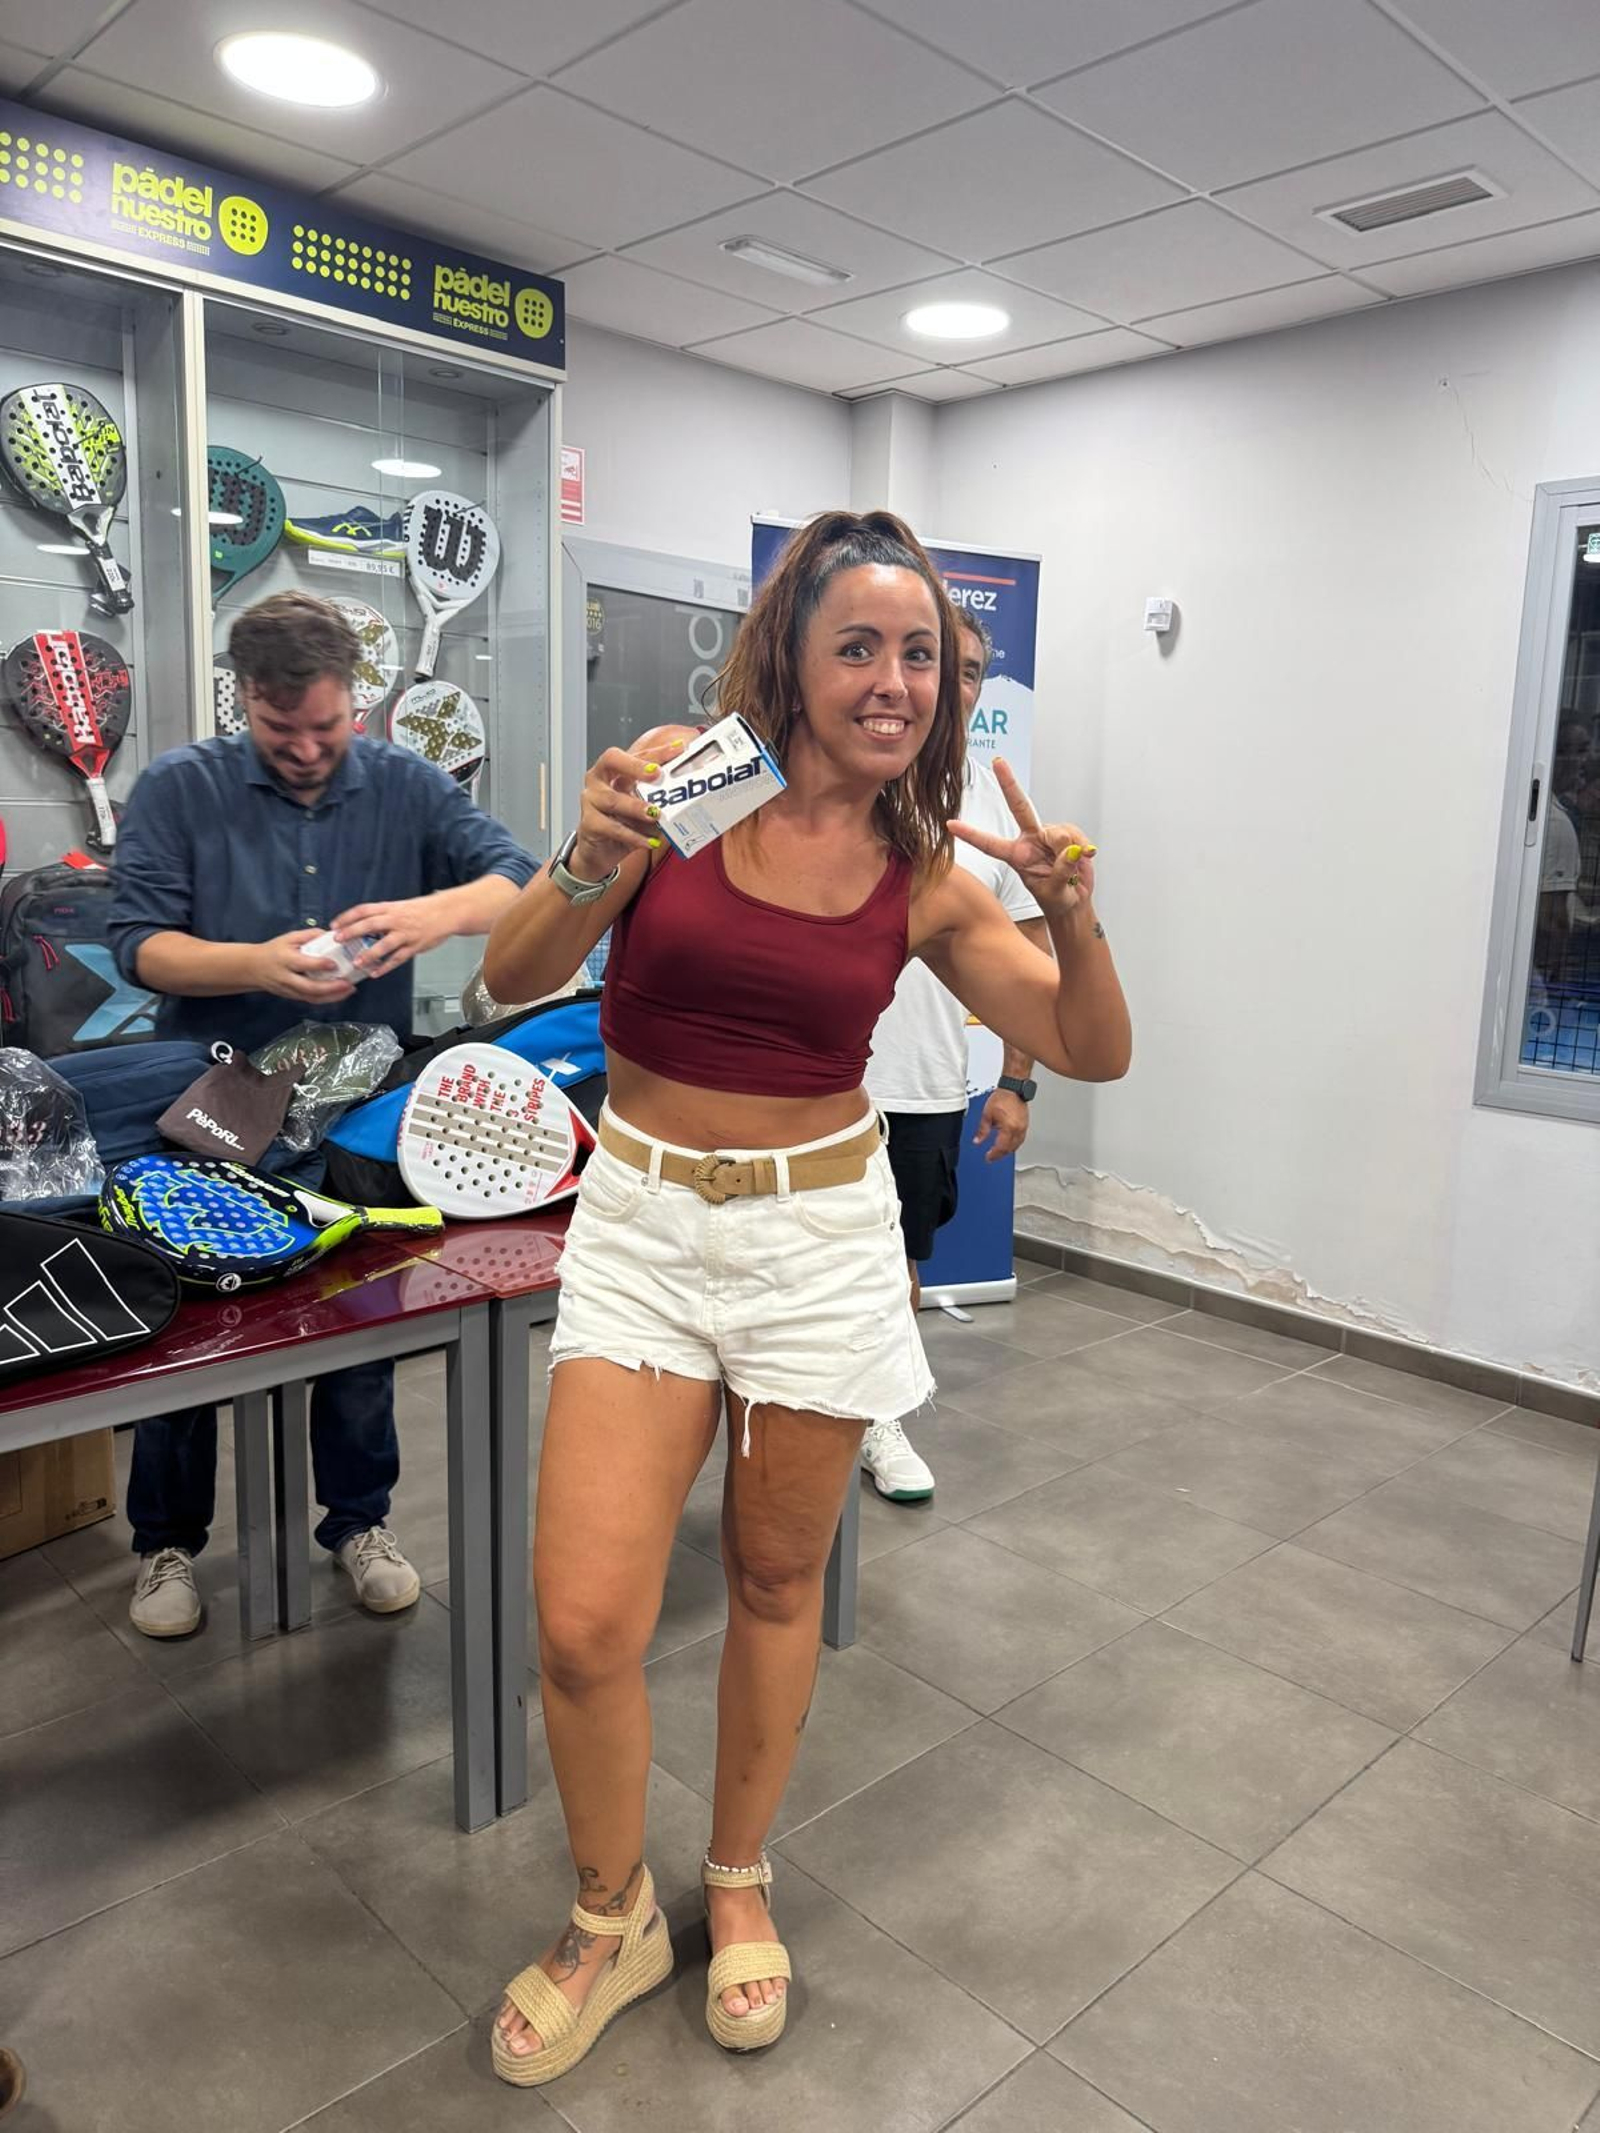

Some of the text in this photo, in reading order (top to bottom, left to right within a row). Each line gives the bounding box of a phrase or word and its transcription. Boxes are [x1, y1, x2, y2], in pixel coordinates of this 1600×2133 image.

[111, 194, 212, 241] nuestro
[138, 226, 186, 249] EXPRESS
[433, 291, 509, 328] nuestro
[453, 317, 489, 336] EXPRESS
[437, 1076, 455, 1099] THE
[457, 1064, 477, 1104] BRAND
[473, 1078, 491, 1108] WITH
[490, 1090, 507, 1112] THE
[524, 1078, 546, 1122] STRIPES
